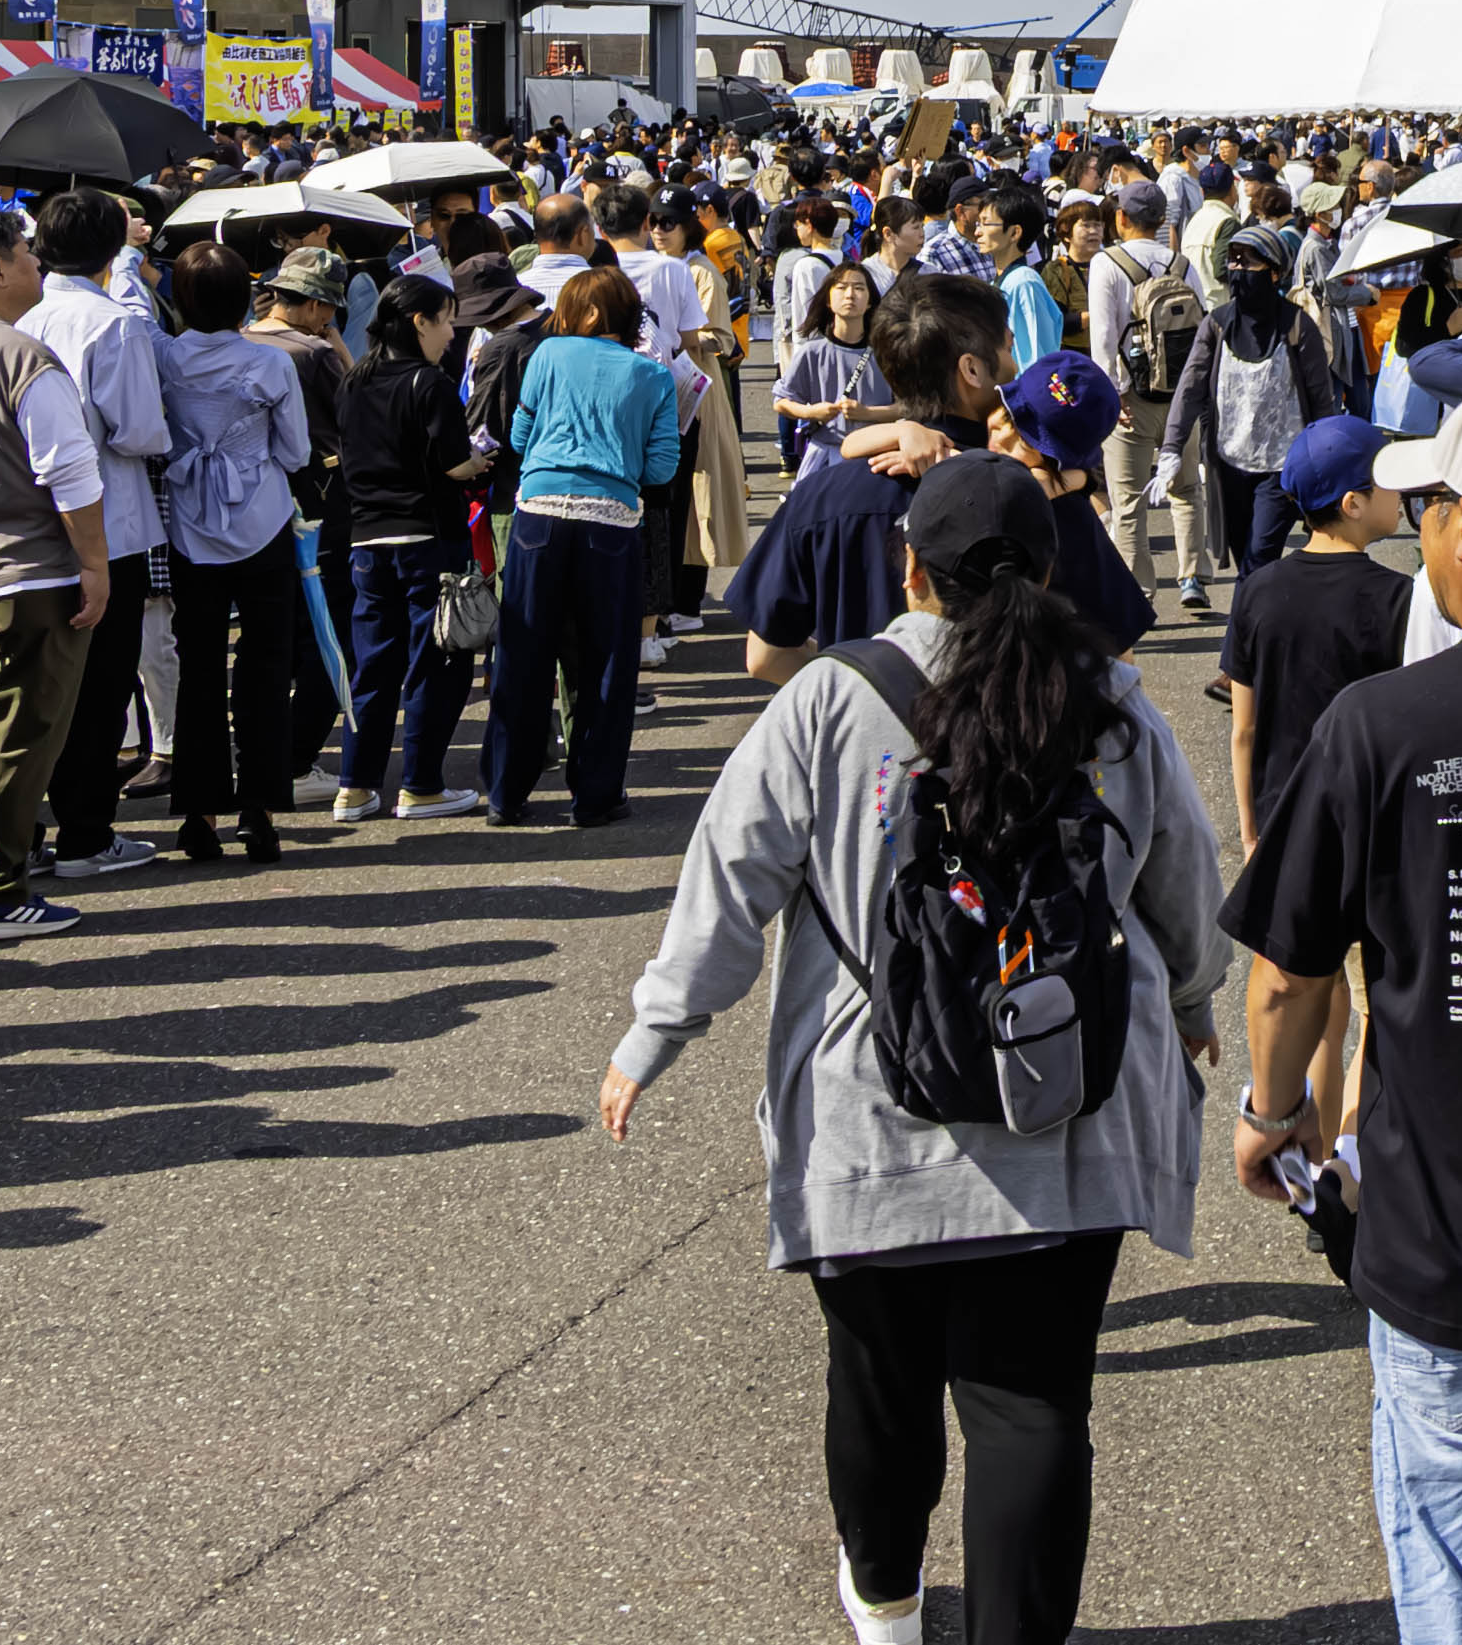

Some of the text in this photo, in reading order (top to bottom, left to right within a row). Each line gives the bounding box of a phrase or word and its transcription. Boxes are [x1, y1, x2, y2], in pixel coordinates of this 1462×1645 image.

[1433, 757, 1462, 772] THE
[1416, 768, 1462, 788] NORTH
[1448, 870, 1458, 879] S.
